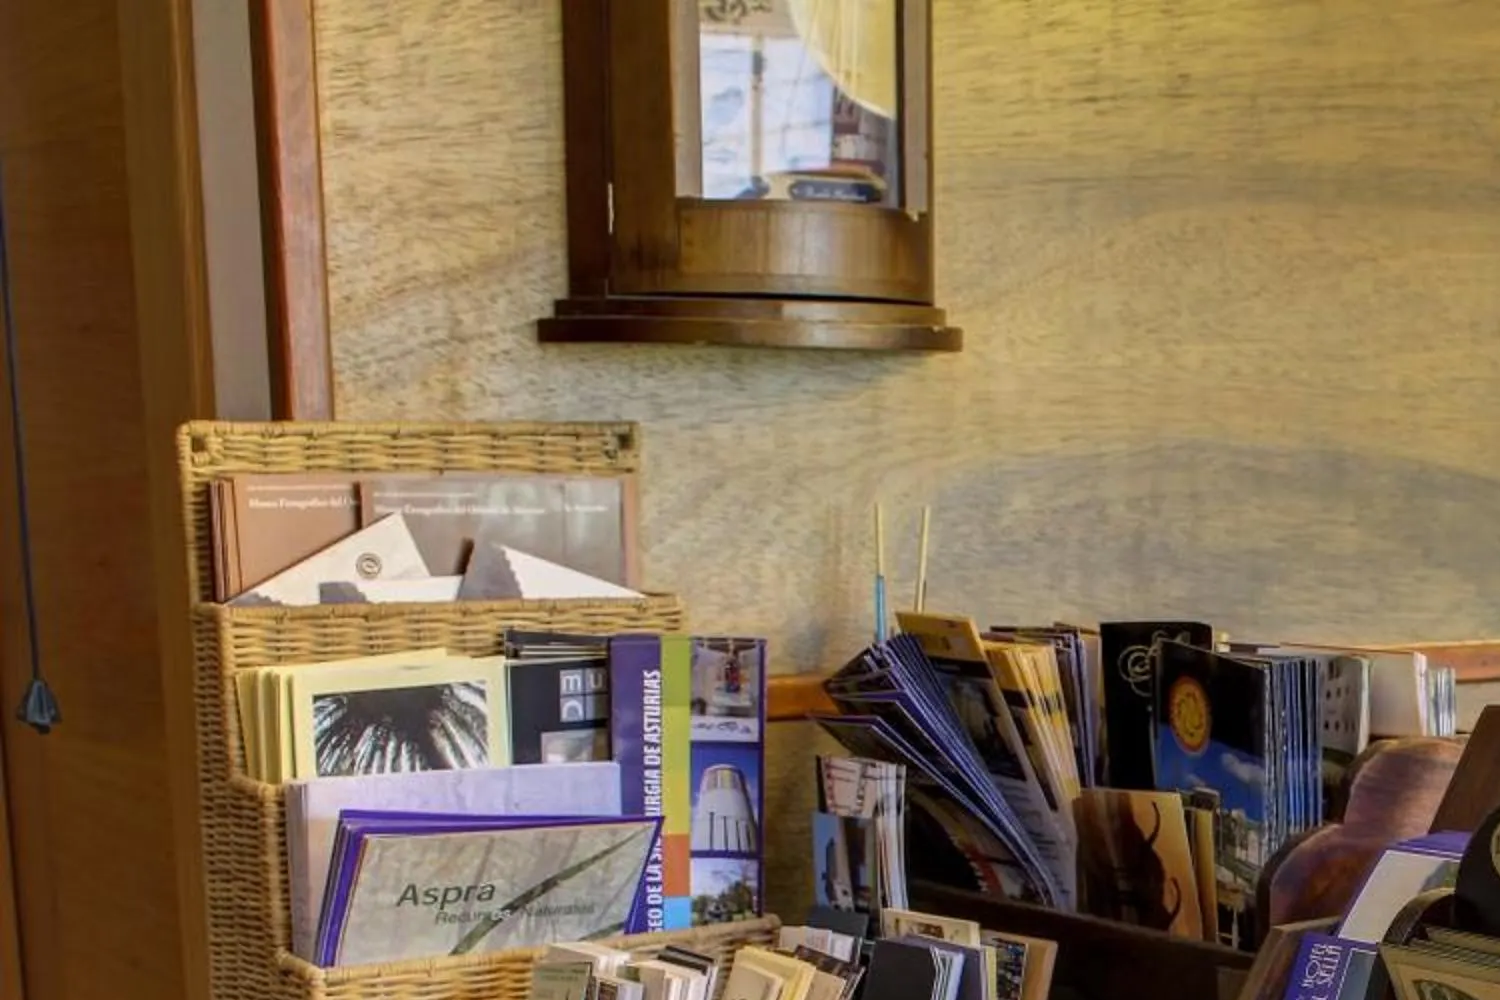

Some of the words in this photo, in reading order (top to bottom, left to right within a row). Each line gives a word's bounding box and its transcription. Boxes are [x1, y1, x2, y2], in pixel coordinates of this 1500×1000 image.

[643, 669, 661, 742] ASTURIAS
[644, 742, 662, 764] DE
[645, 863, 662, 882] LA
[396, 883, 496, 911] Aspra
[646, 884, 663, 904] DE
